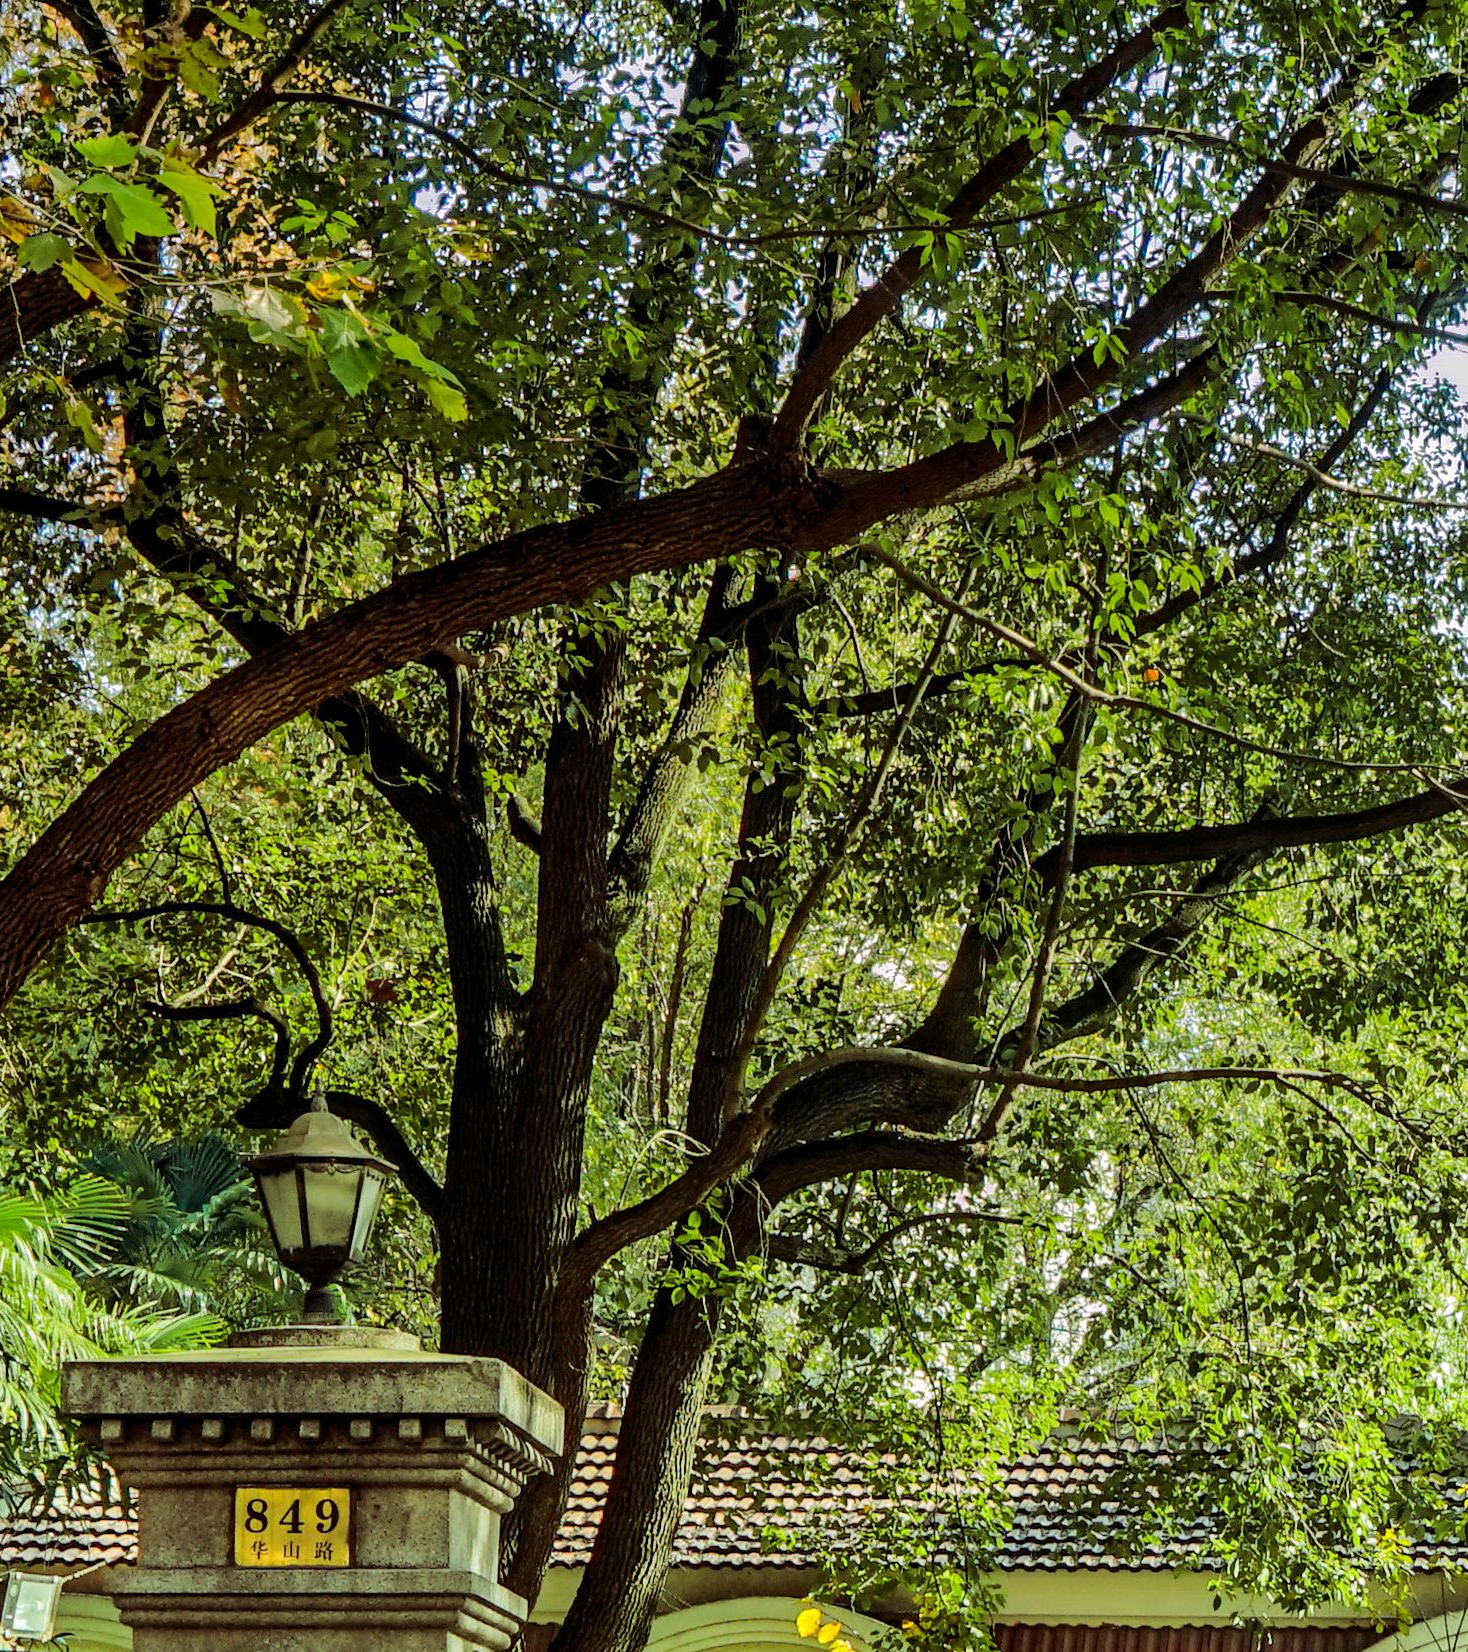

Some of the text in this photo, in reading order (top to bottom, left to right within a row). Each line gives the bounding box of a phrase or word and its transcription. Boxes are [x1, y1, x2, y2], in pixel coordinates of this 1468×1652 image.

[244, 1499, 340, 1534] 849
[251, 1540, 334, 1561] 华山路
